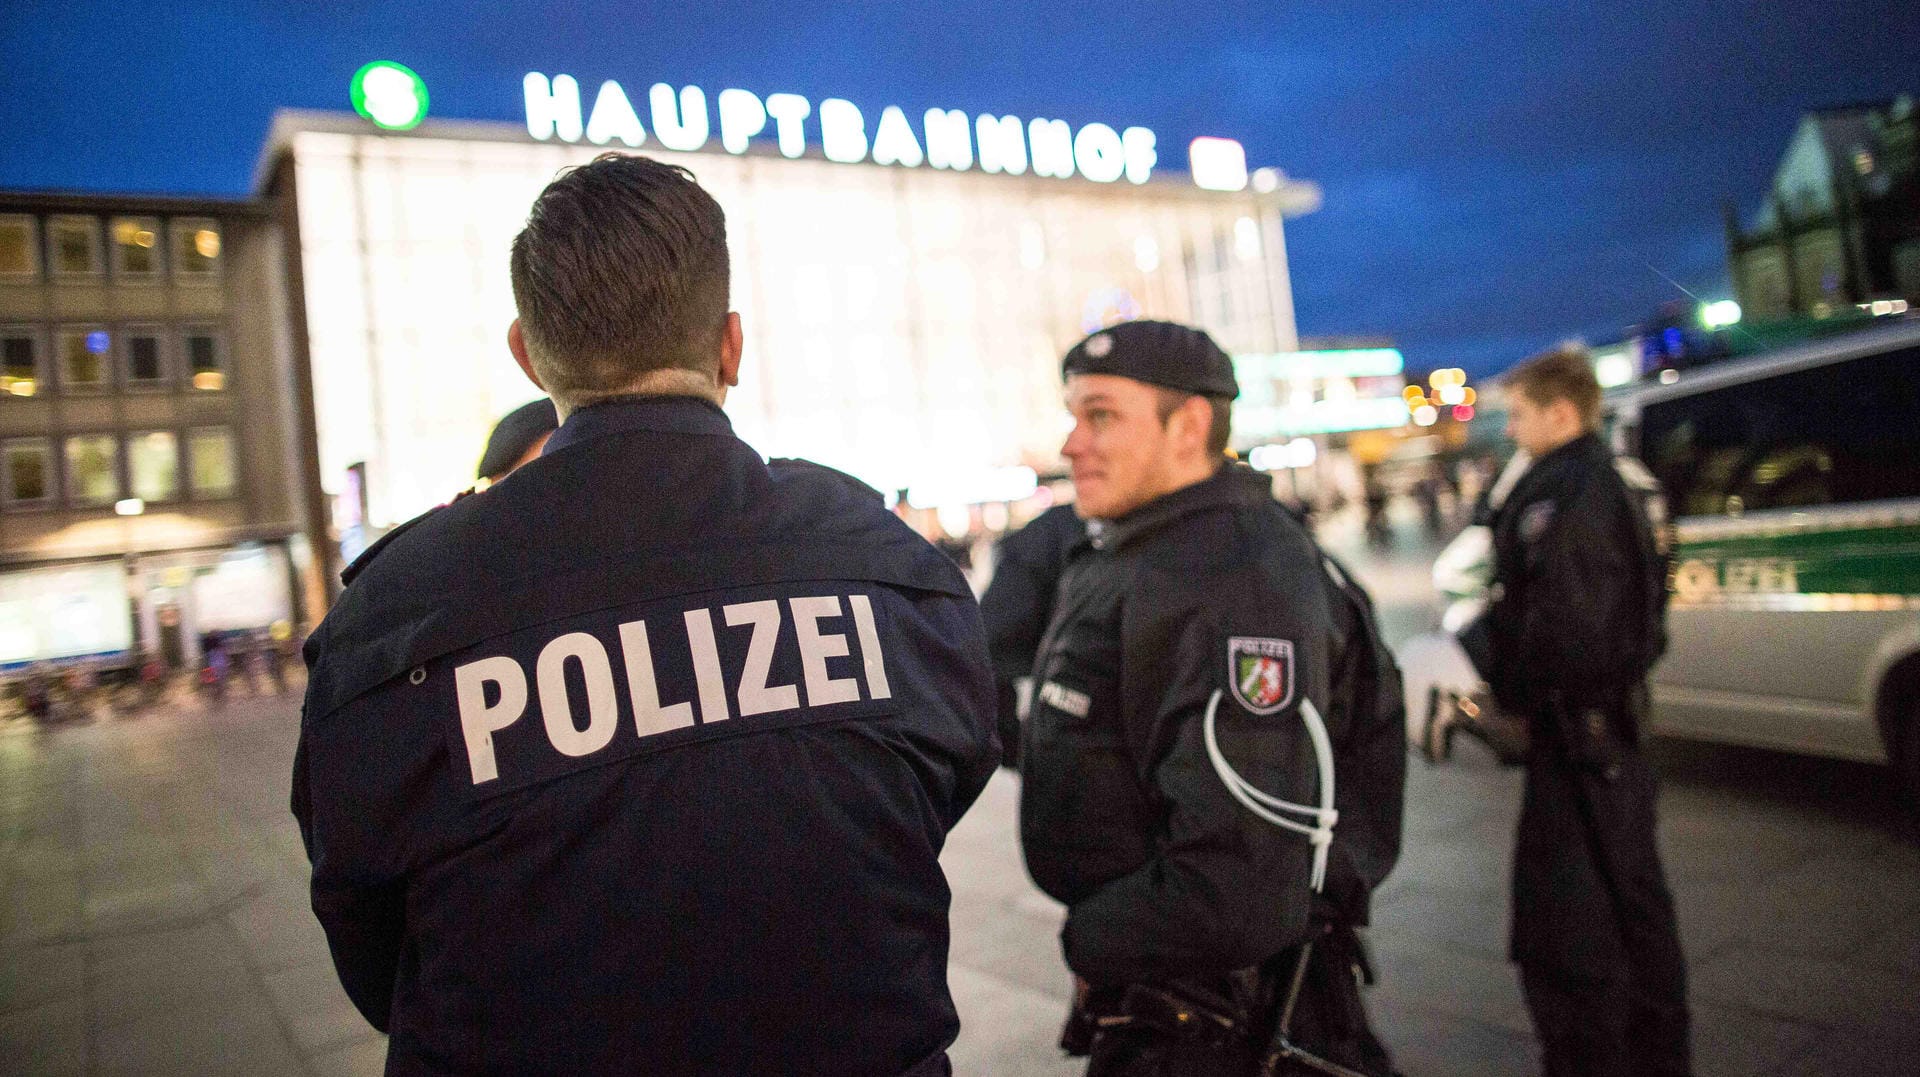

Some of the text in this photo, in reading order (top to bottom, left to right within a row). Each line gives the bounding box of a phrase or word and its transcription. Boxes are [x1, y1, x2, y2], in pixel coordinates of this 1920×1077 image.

[523, 71, 1158, 185] HAUPTBAHNHOF
[1668, 556, 1798, 597] OLIZEI
[455, 595, 892, 785] POLIZEI
